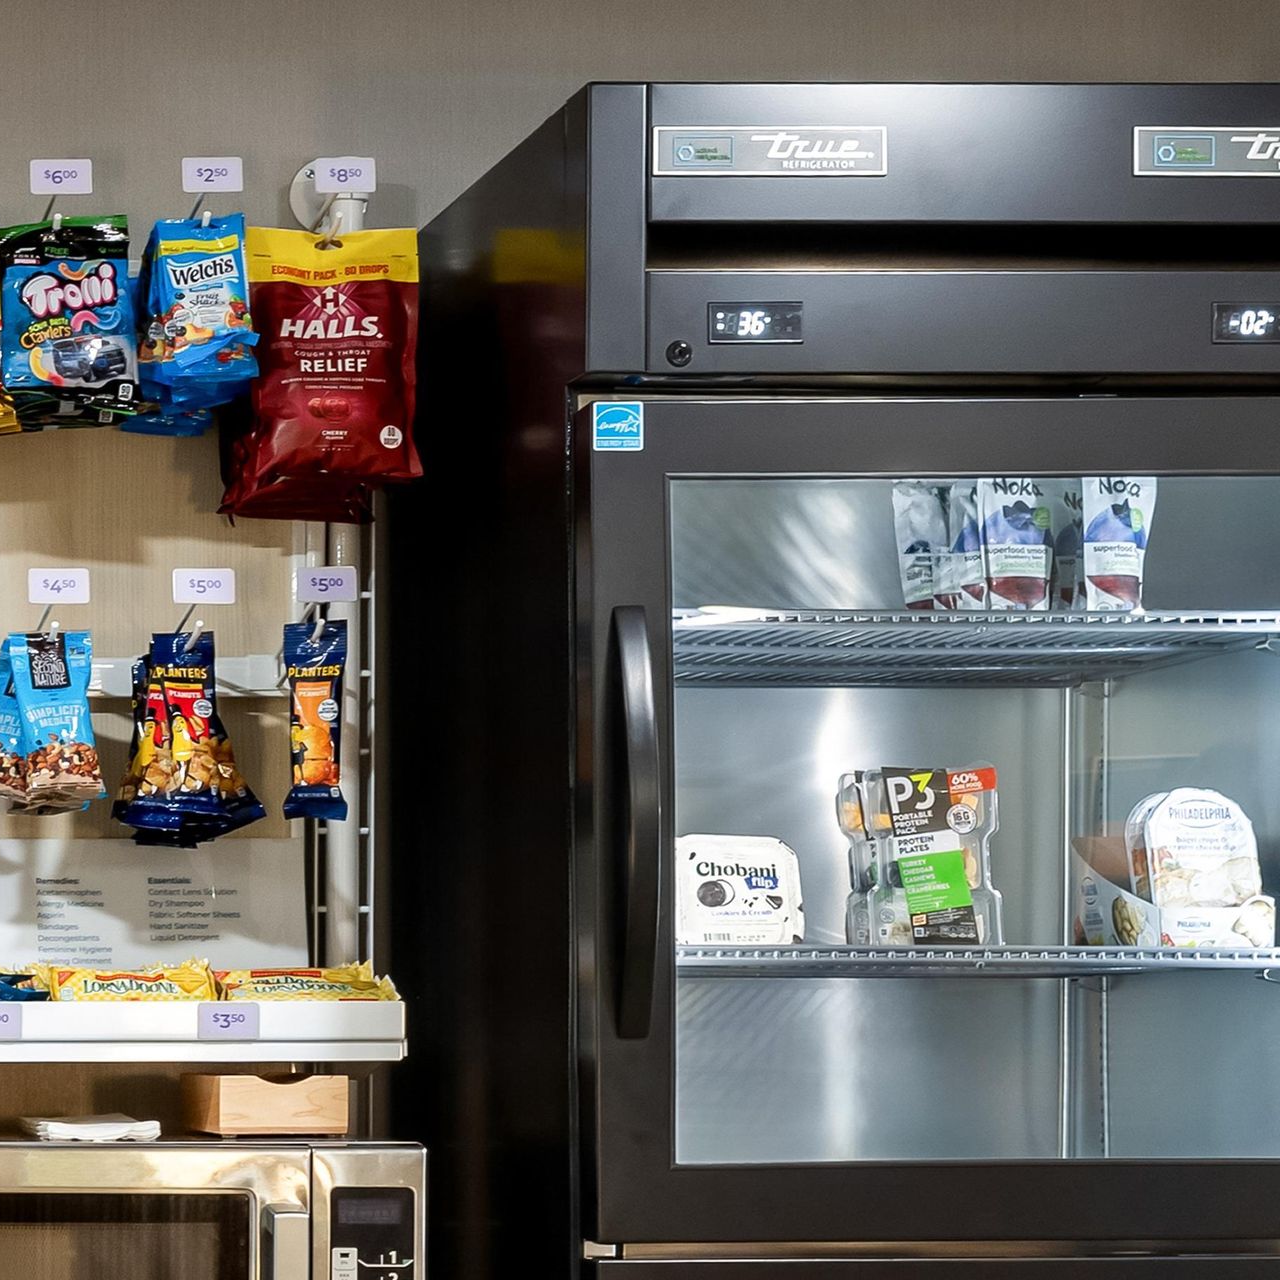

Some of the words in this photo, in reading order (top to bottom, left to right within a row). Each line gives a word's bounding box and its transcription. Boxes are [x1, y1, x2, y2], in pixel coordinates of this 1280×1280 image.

[751, 132, 870, 159] true
[782, 160, 856, 169] REFRIGERATOR
[170, 257, 235, 288] Welch's
[313, 266, 336, 278] PACK
[357, 264, 390, 276] DROPS
[22, 262, 117, 319] Trolli
[737, 311, 765, 335] 36
[19, 324, 72, 350] Crawlers
[294, 349, 321, 357] COUGH
[299, 357, 368, 373] RELIEF
[157, 667, 207, 679] PLANTERS
[288, 665, 341, 678] PLANTERS
[951, 772, 979, 785] 60%
[886, 772, 935, 814] P3
[893, 810, 934, 822] PORTABLE
[1169, 807, 1232, 820] PHILADELPHIA
[894, 818, 929, 829] PROTEIN
[895, 826, 918, 835] PACK
[898, 835, 934, 847] PROTEIN
[898, 844, 930, 855] PLATES
[696, 861, 776, 878] Chobani
